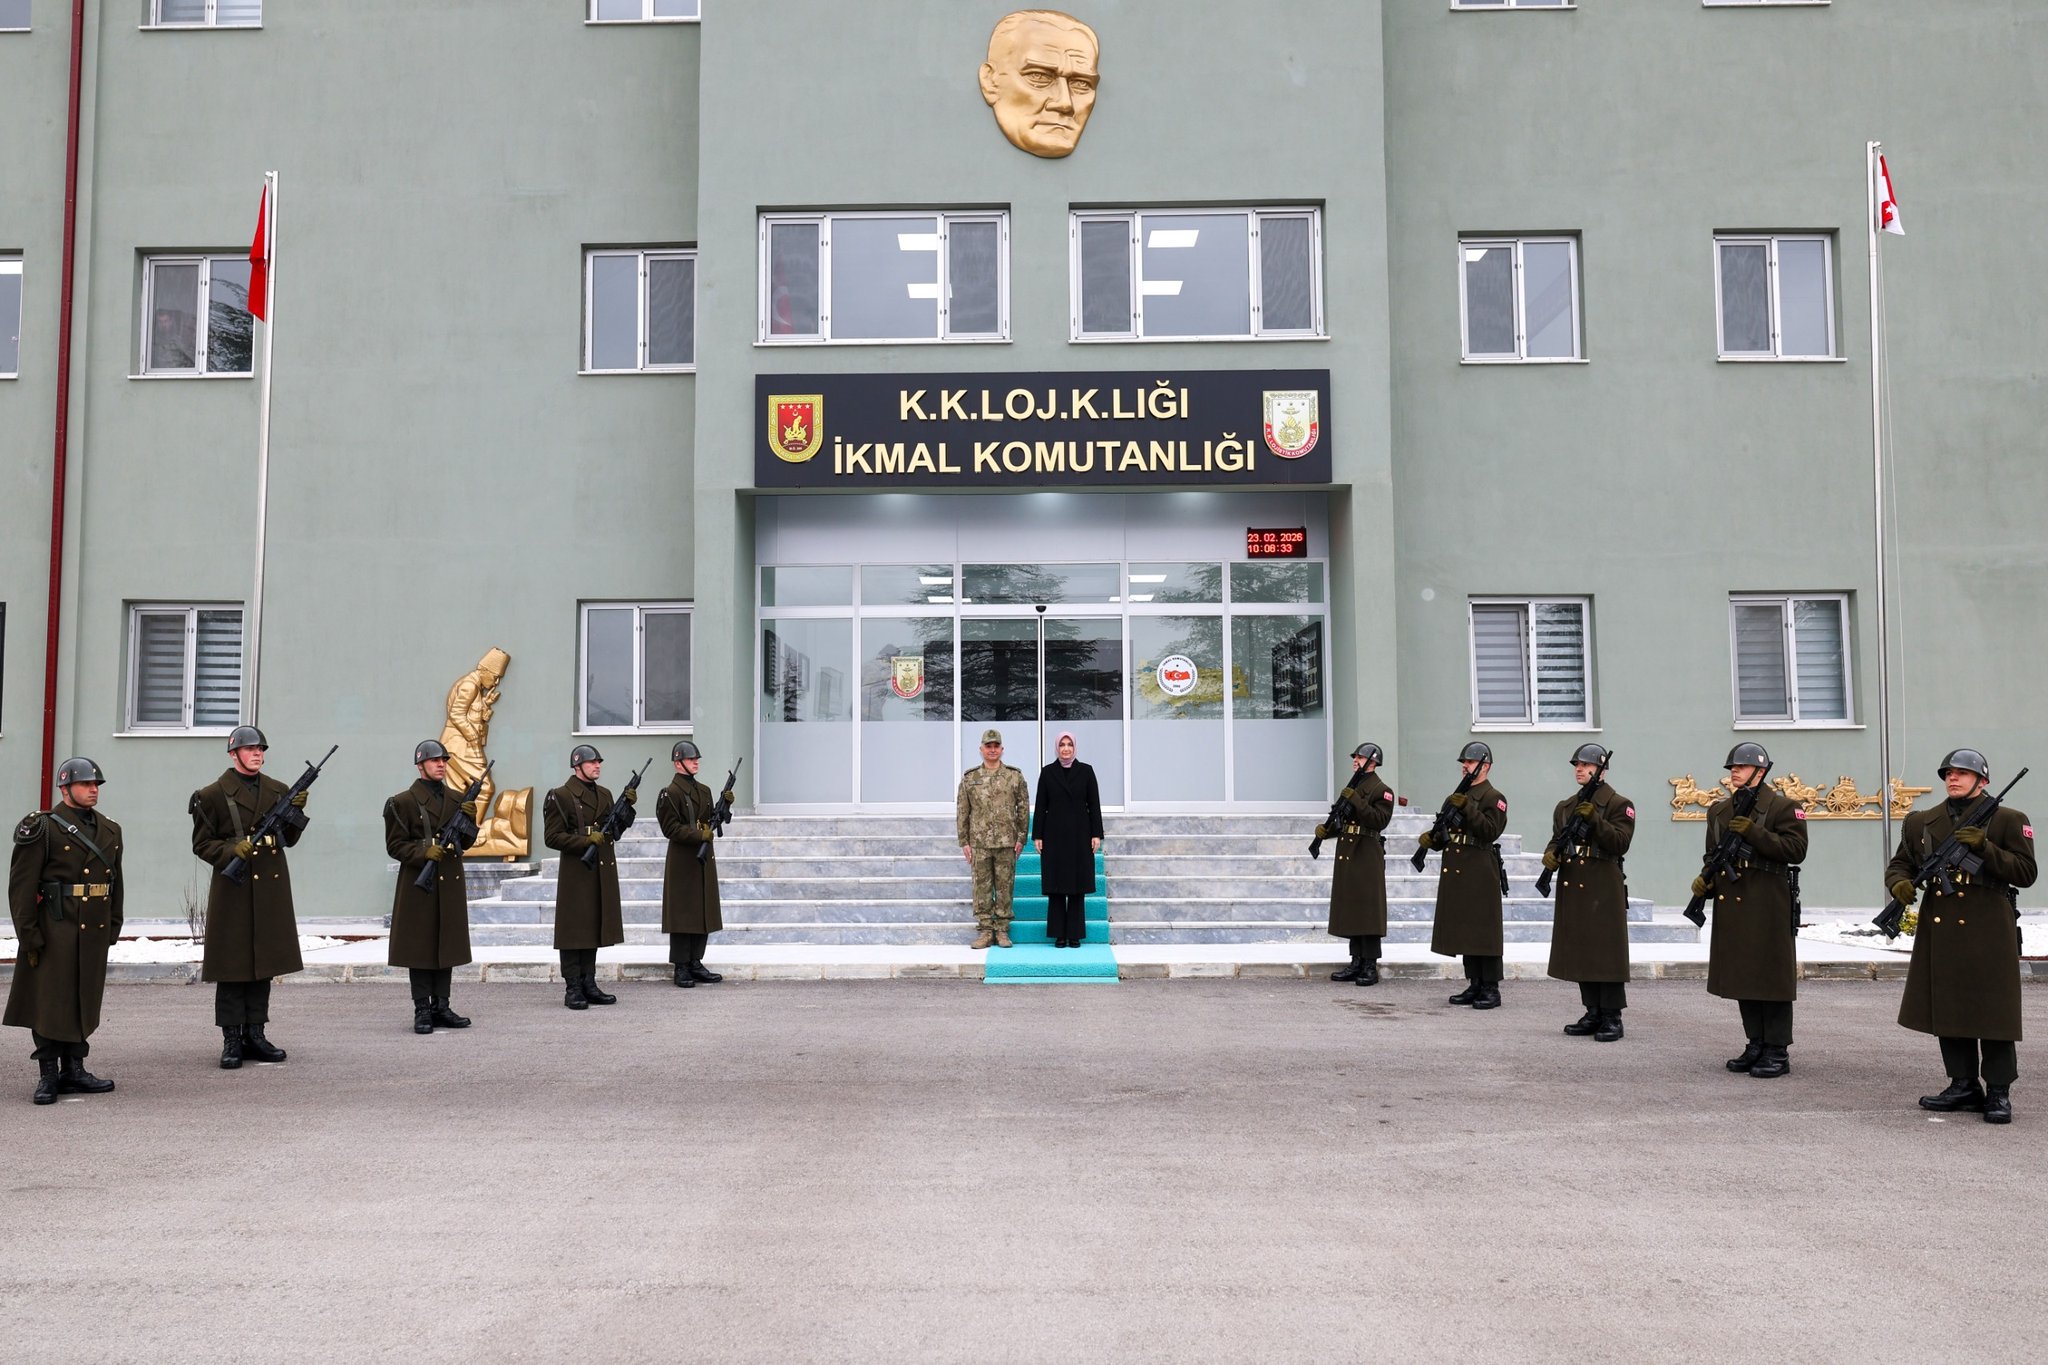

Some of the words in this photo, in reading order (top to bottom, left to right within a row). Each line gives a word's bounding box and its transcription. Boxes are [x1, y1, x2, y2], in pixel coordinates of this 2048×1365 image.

[900, 379, 1188, 420] K.K.LOJ.K.LIĞI
[834, 436, 961, 474] İKMAL
[974, 432, 1255, 473] KOMUTANLIĞI
[1248, 544, 1292, 553] 10:08:33
